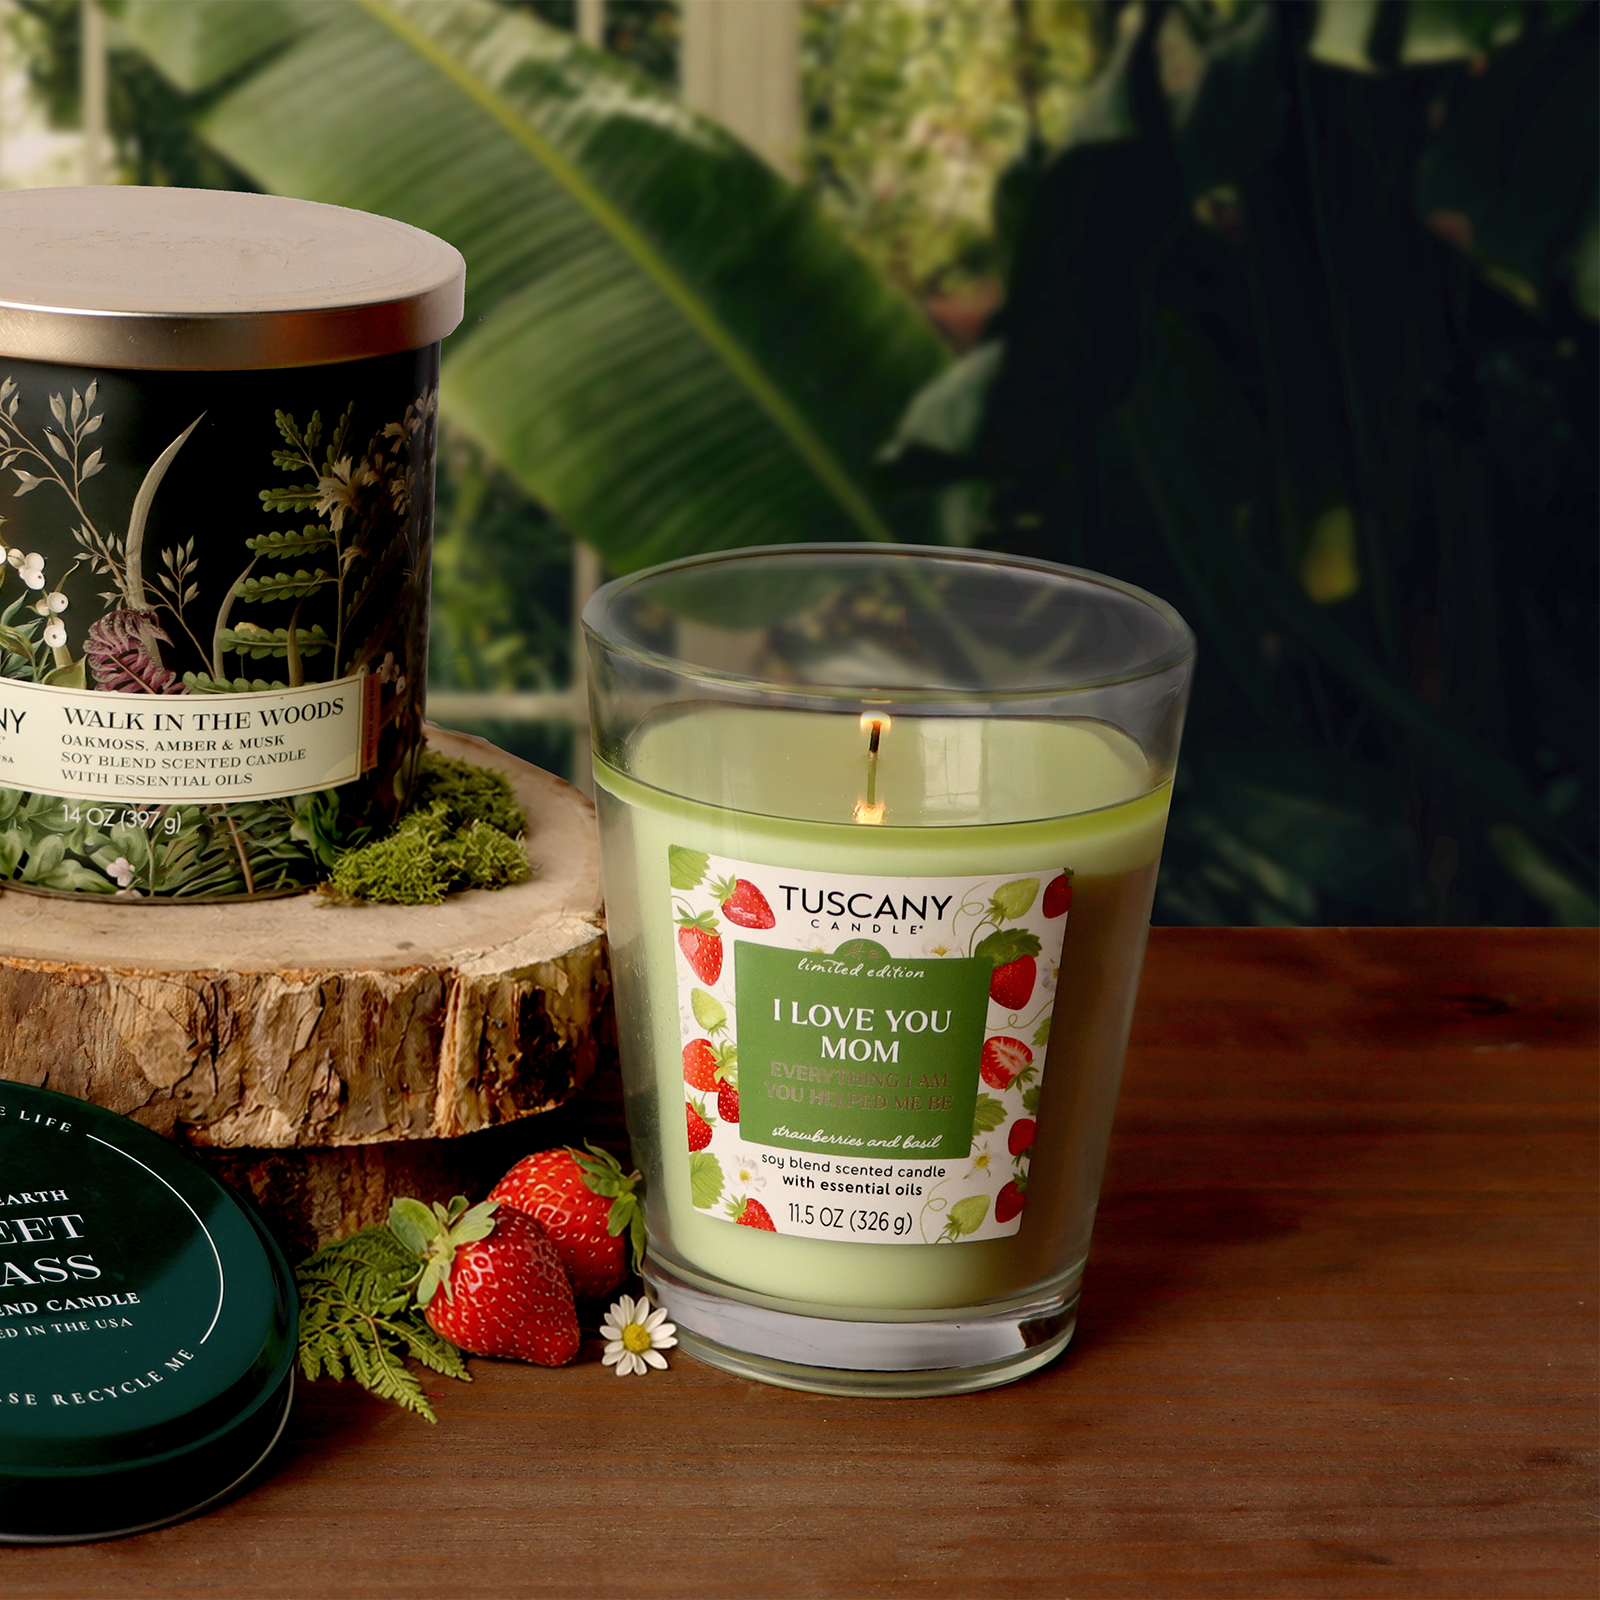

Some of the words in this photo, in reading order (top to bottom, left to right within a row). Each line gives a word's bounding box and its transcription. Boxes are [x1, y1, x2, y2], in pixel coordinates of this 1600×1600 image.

[64, 707, 144, 729] WALK
[153, 713, 184, 731] IN
[192, 712, 251, 731] THE
[258, 697, 344, 727] WOODS
[61, 734, 149, 752] OAKMOSS,
[154, 740, 217, 751] AMBER
[222, 740, 234, 750] &
[239, 735, 285, 749] MUSK
[61, 752, 93, 764] SOY
[98, 756, 156, 769] BLEND
[161, 757, 241, 770] SCENTED
[246, 749, 306, 765] CANDLE
[61, 770, 108, 784] WITH
[114, 774, 211, 786] ESSENTIAL
[215, 773, 253, 785] OILS
[62, 804, 81, 823] 14
[86, 807, 116, 827] OZ
[120, 809, 161, 831] (397
[164, 811, 181, 835] g)
[779, 885, 953, 921] TUSCANY
[798, 958, 864, 977] limited
[867, 966, 925, 978] edition
[773, 998, 782, 1021] I
[791, 1001, 875, 1031] LOVE
[886, 1009, 952, 1033] YOU
[820, 1036, 899, 1063] MOM
[770, 1061, 899, 1089] EVERYTHING
[905, 1074, 912, 1088] I
[916, 1074, 948, 1089] AM
[764, 1082, 804, 1102] YOU
[809, 1089, 887, 1110] HELPED
[893, 1094, 922, 1110] ME
[929, 1095, 953, 1111] BE
[19, 1109, 72, 1133] LIFE
[772, 1125, 864, 1147] strawberries
[867, 1135, 898, 1148] and
[902, 1135, 940, 1150] basil
[761, 1153, 784, 1169] soy
[789, 1156, 830, 1172] blend
[835, 1162, 894, 1177] scented
[898, 1165, 946, 1178] candle
[782, 1174, 815, 1189] with
[820, 1179, 890, 1195] essential
[895, 1183, 922, 1196] oils
[789, 1203, 815, 1225] 11.5
[819, 1206, 844, 1227] OZ
[849, 1208, 889, 1232] (326
[894, 1212, 913, 1235] g)
[45, 1291, 140, 1315] CANDLE
[24, 1325, 45, 1336] IN
[51, 1320, 90, 1333] THE
[95, 1317, 134, 1329] USA
[53, 1370, 164, 1405] RECYCLE
[164, 1347, 194, 1372] ME
